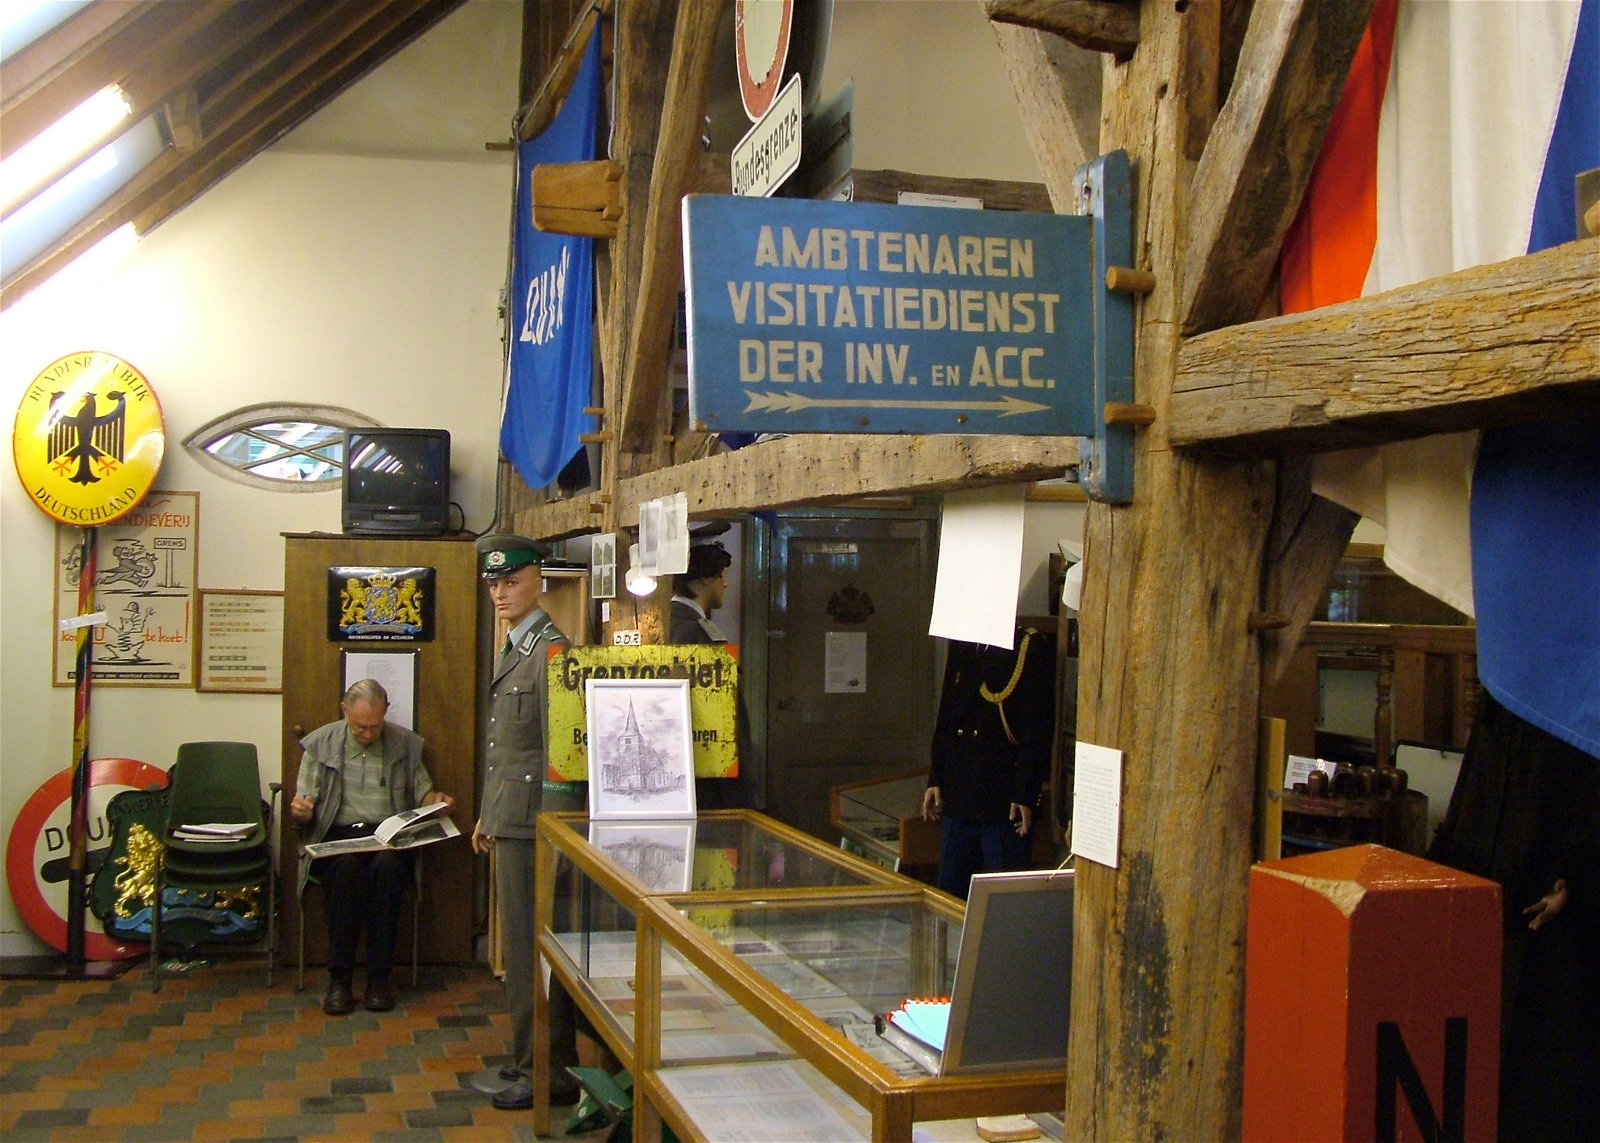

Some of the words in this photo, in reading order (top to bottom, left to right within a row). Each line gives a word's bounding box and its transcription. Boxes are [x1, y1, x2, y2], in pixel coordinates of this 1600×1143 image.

[735, 108, 798, 196] Bundesgrenze
[755, 225, 1034, 278] AMBTENAREN
[727, 281, 1060, 334] VISITATIEDIENST
[30, 356, 150, 402] BUNDESRUBLIK
[739, 339, 823, 383] DER
[845, 342, 918, 386] INV.
[931, 364, 960, 387] EN
[969, 345, 1055, 389] ACC.
[35, 487, 136, 522] DEUTSCHLAND
[116, 512, 190, 527] NDIEVERIJ
[92, 626, 106, 641] U
[143, 628, 155, 641] te
[1375, 1016, 1468, 1143] N
